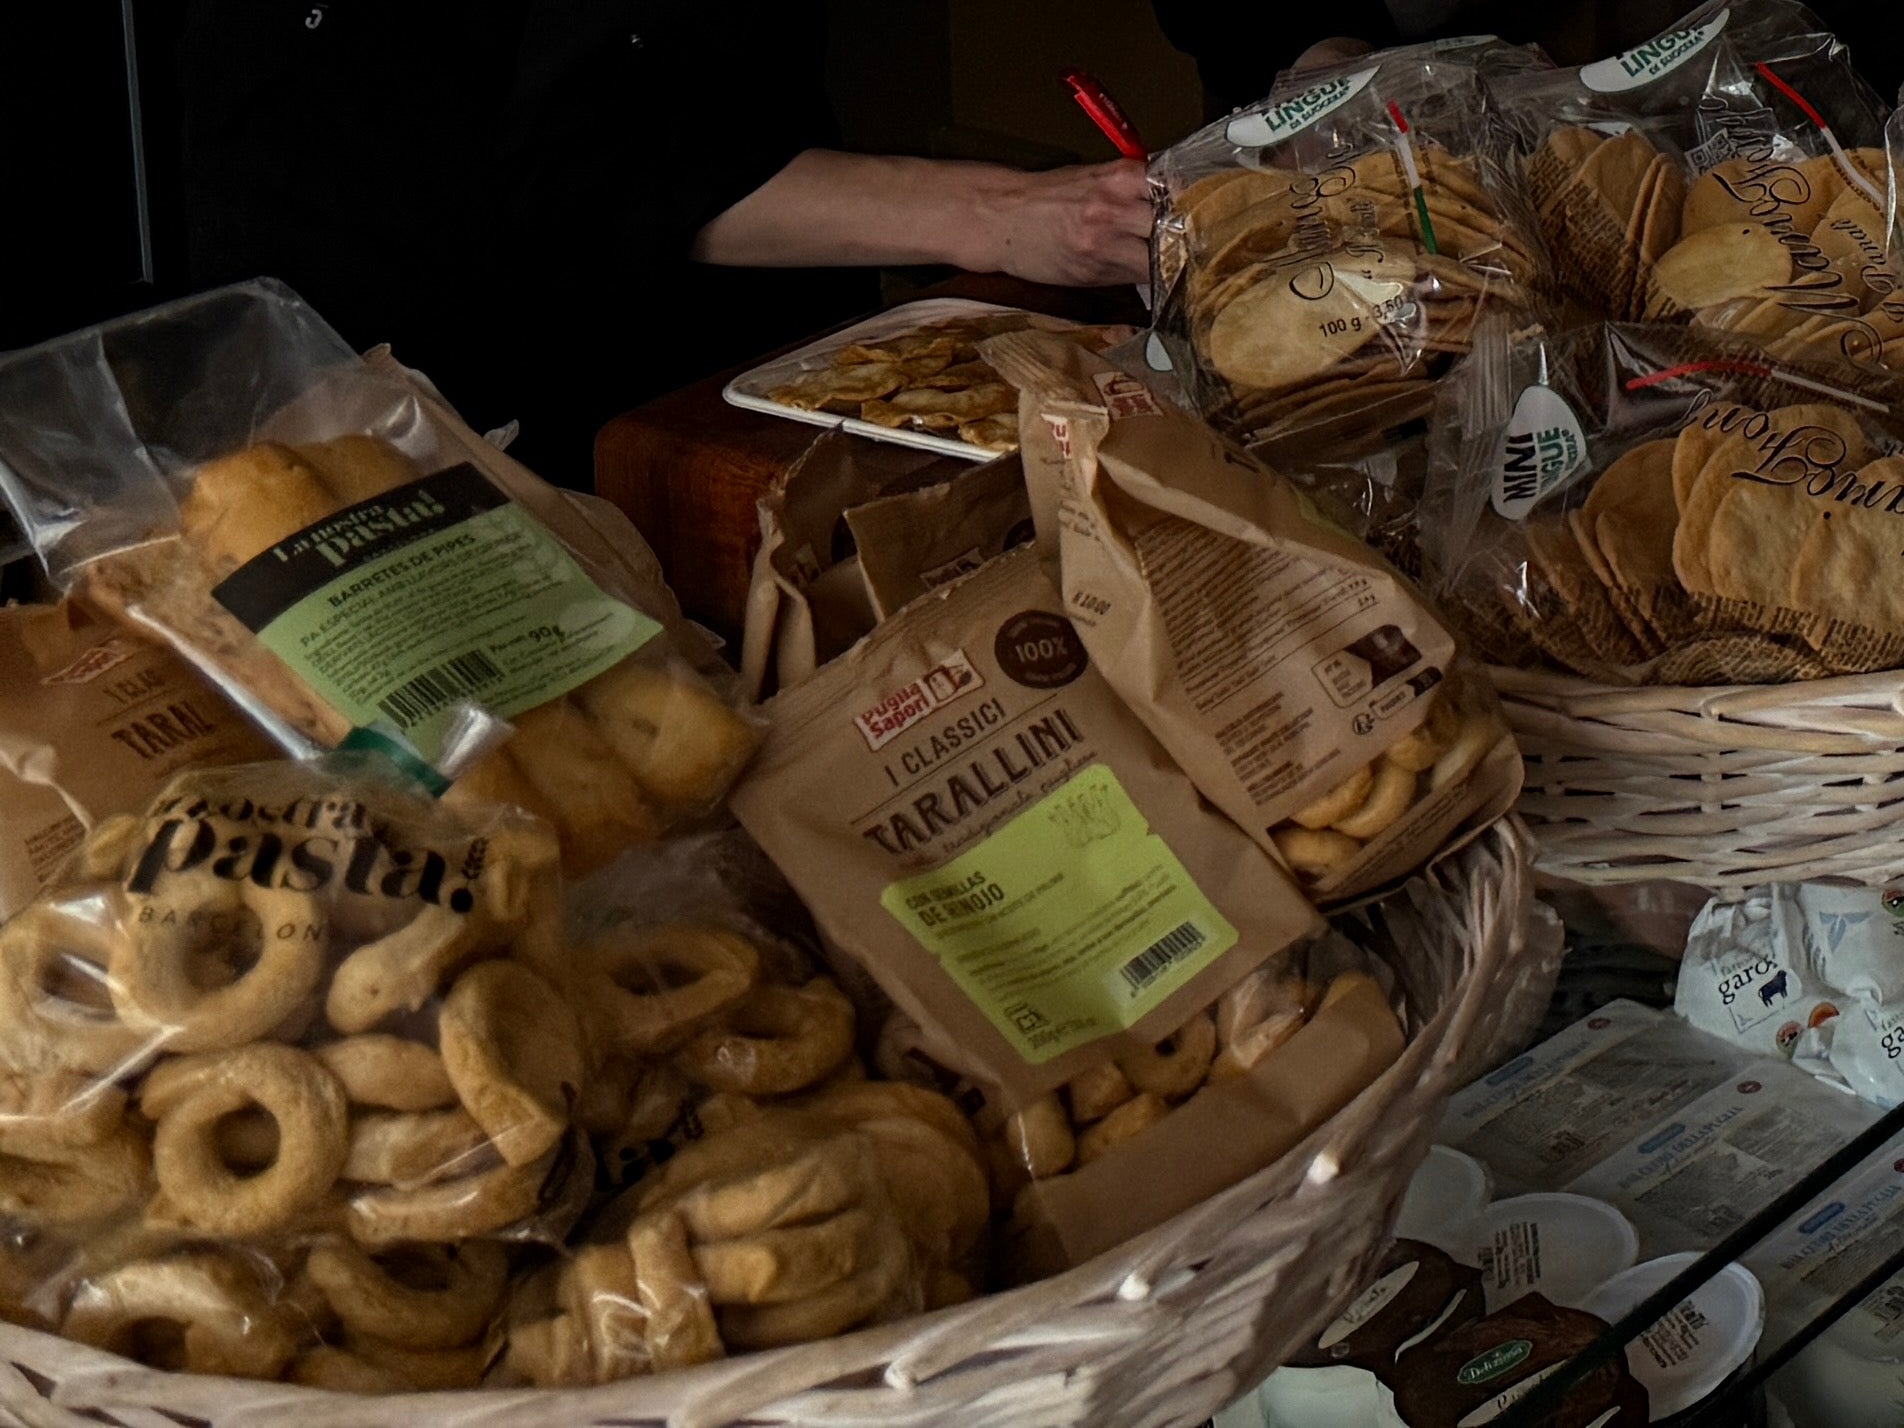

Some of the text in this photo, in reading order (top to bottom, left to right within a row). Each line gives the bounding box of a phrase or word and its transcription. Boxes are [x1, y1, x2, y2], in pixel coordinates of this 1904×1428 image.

[1318, 318, 1347, 338] 100
[1351, 316, 1362, 334] g
[1503, 433, 1537, 504] MINI
[317, 488, 446, 569] pasta!
[327, 532, 477, 607] BARRETES DE PIPES
[1014, 636, 1069, 664] 100%
[110, 700, 214, 761] TARAL
[869, 695, 930, 740] Sapori
[884, 696, 1007, 787] I CLASSICI
[863, 708, 1085, 854] TARALLINI
[127, 816, 491, 916] pasta!
